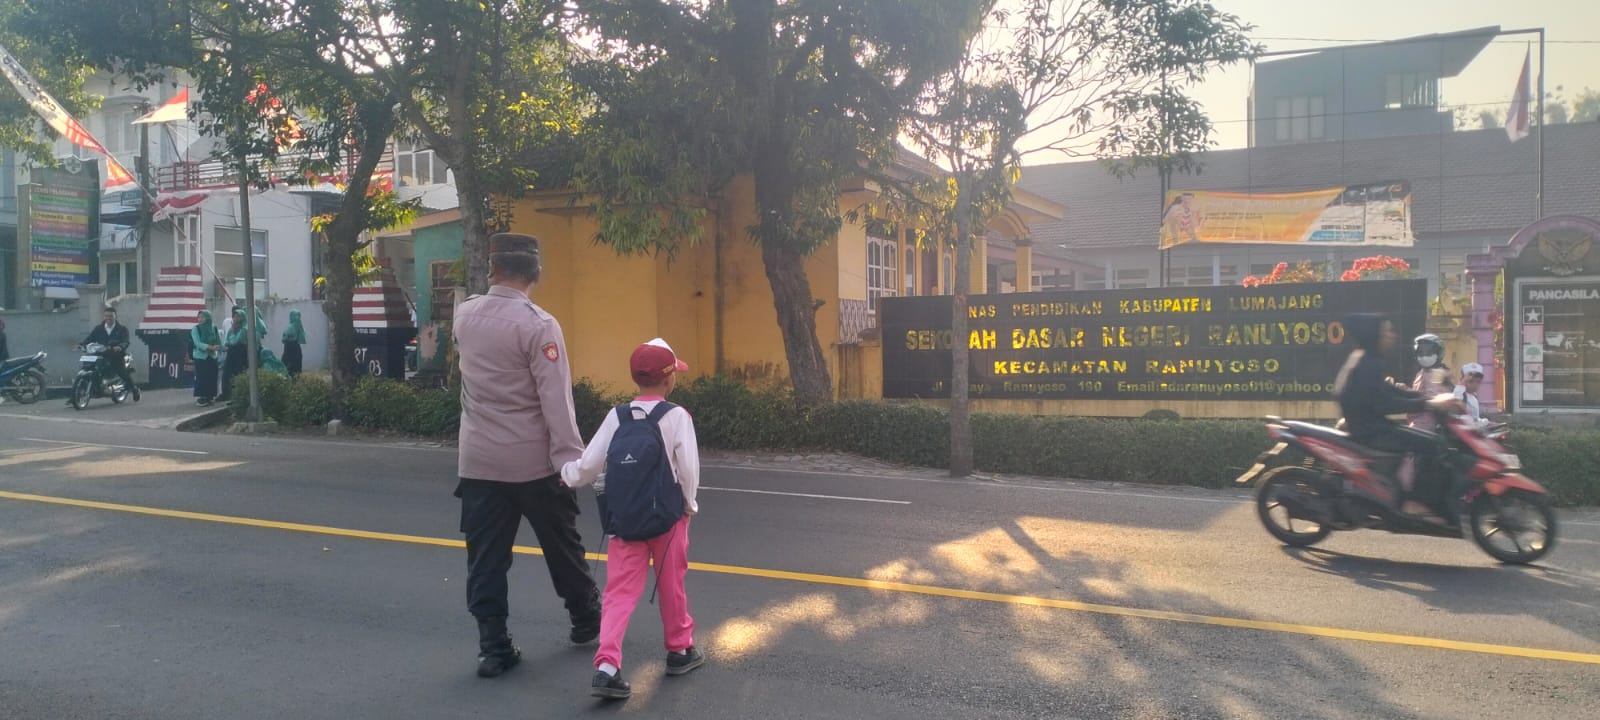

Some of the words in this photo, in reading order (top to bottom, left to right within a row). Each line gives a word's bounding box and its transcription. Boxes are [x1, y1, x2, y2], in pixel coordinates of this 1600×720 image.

[1528, 289, 1600, 300] PANCASILA
[968, 304, 997, 318] NAS
[1012, 301, 1103, 317] PENDIDIKAN
[1119, 297, 1212, 314] KABUPATEN
[1230, 294, 1323, 311] LUMAJANG
[905, 328, 997, 350] SEKOAH
[1012, 326, 1085, 349] DASAR
[1102, 324, 1191, 348] NEGERI
[1208, 321, 1345, 347] RANUYOSO
[369, 360, 382, 376] 03
[994, 359, 1127, 374] KECAMATAN
[1145, 358, 1280, 374] RANUYOSO
[968, 383, 992, 394] aya
[1003, 381, 1067, 394] Ranuyoso
[1078, 380, 1103, 392] 190
